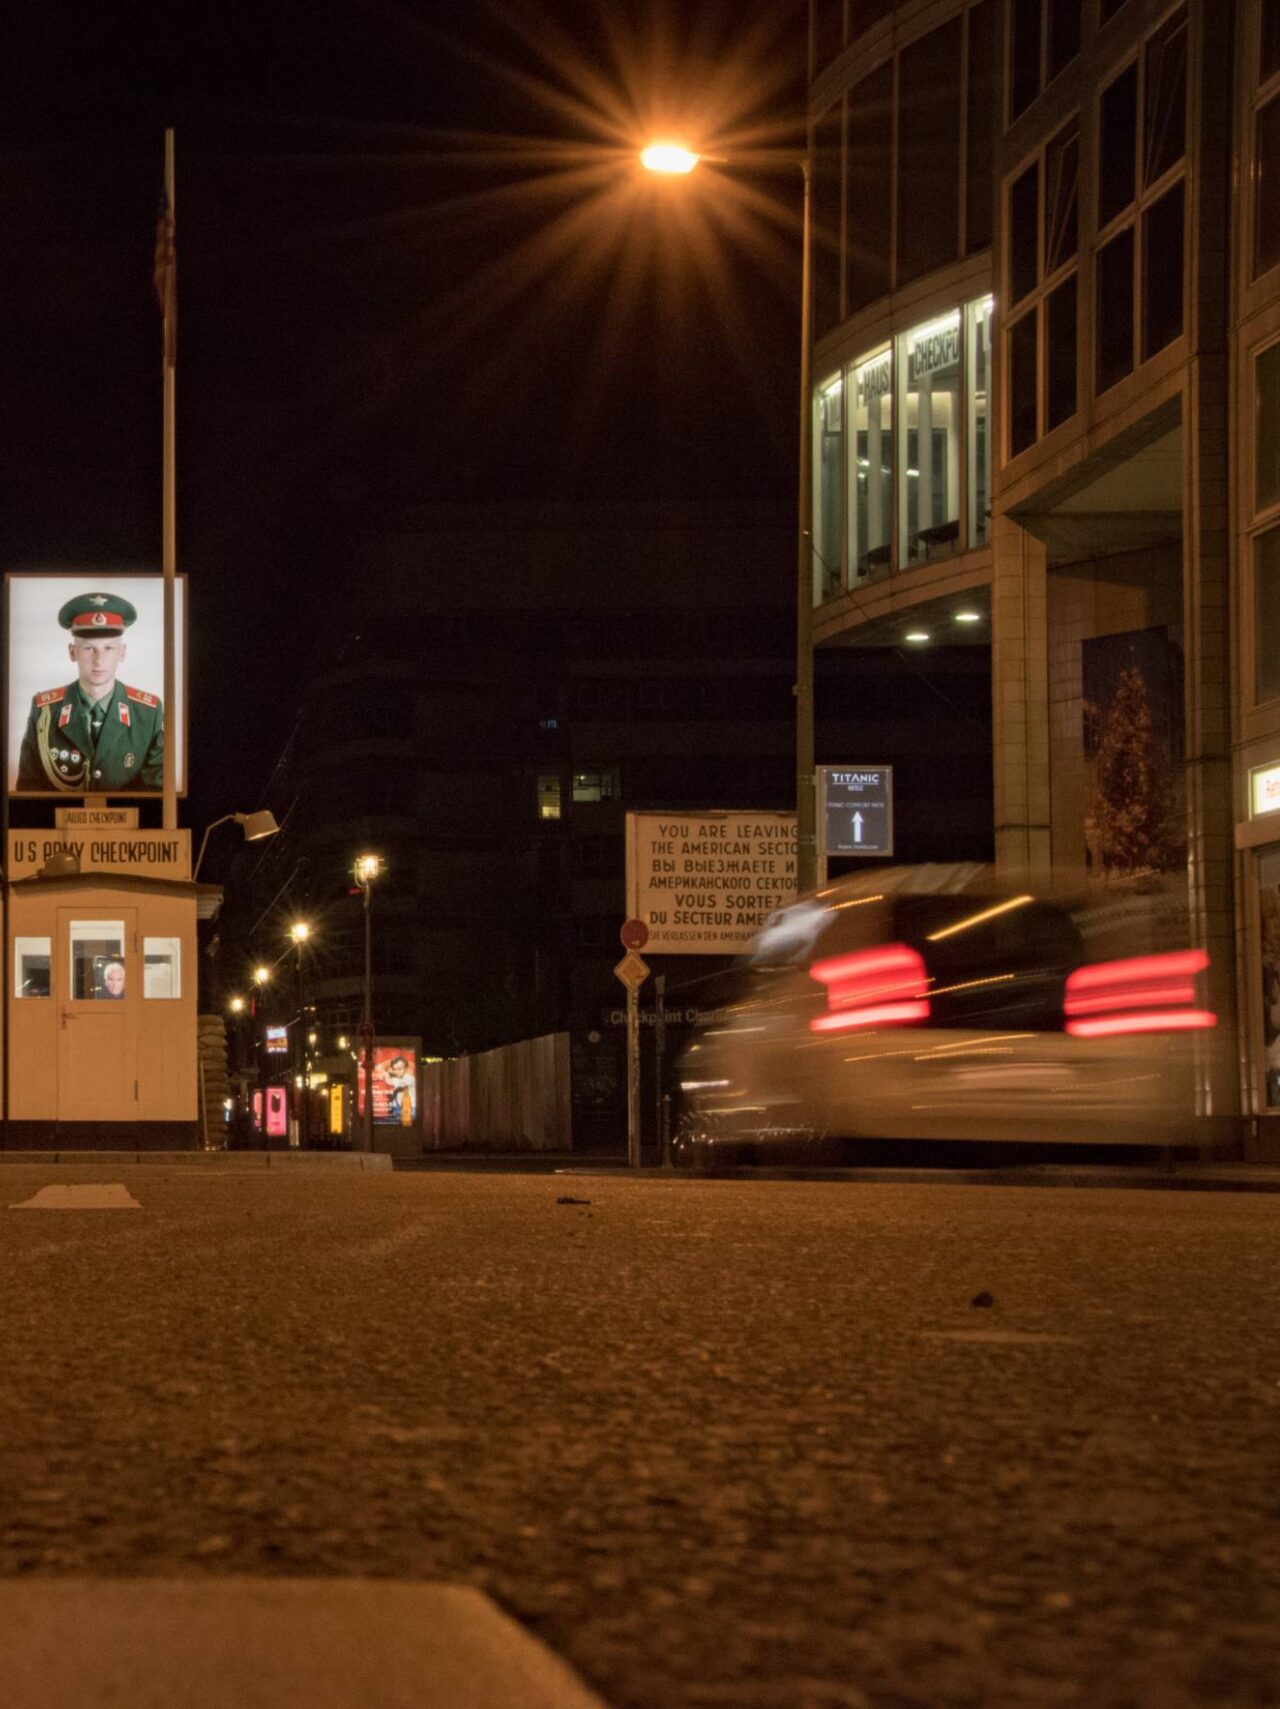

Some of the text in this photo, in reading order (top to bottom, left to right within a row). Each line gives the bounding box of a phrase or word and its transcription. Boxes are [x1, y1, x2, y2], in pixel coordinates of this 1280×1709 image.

[914, 327, 959, 375] CHECKPO
[832, 773, 880, 783] TITANIC
[67, 812, 127, 824] ALLIED CHECKPOINT
[658, 824, 799, 838] YOU ARE LEAVING
[90, 841, 179, 863] CHECKPOINT
[650, 841, 799, 855] THE AMERICAN SECTO
[652, 859, 795, 873] ВЫ ВЫЕЗЖАЕТЕ И
[649, 876, 799, 890] АМЕРИКАНСКОГО СЕКТОР
[674, 894, 783, 909] VOUS SORTEZ
[650, 911, 766, 926] DU SECTEUR AME
[661, 930, 702, 941] VERLASSEN
[703, 931, 718, 941] DEN
[610, 1009, 682, 1026] Chkpint
